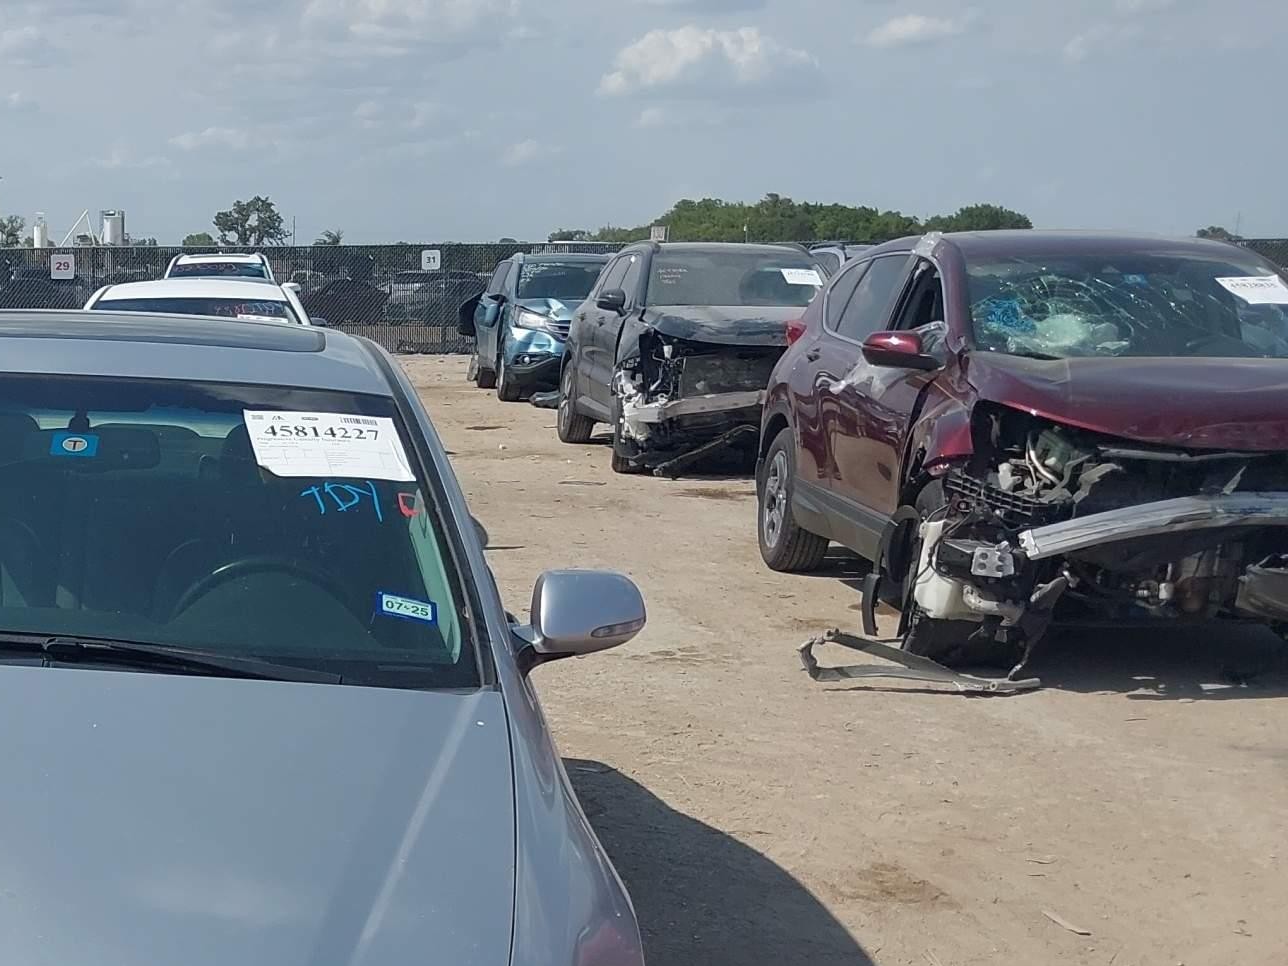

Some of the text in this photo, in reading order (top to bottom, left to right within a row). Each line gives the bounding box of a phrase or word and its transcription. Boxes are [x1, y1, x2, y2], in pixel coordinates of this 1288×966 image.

[426, 256, 436, 264] 31
[55, 261, 70, 271] 29
[264, 425, 379, 440] 45814227
